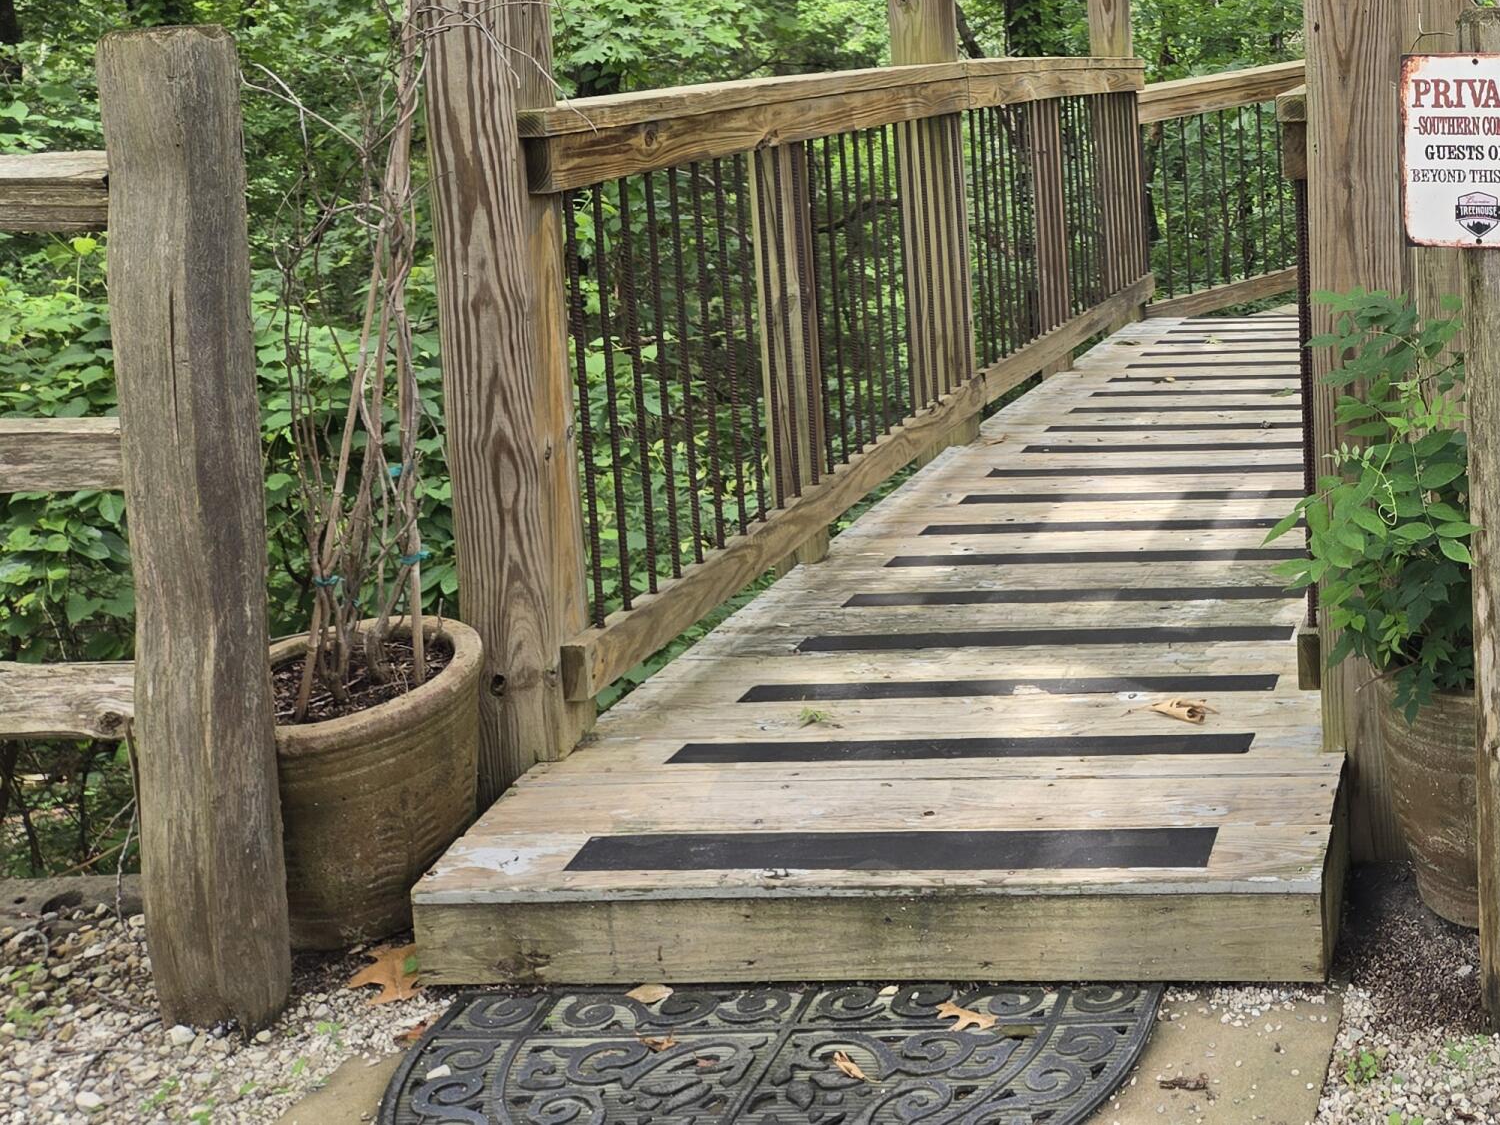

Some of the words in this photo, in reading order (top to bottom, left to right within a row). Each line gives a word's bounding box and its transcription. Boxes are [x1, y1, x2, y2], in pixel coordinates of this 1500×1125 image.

[1424, 144, 1485, 161] GUESTS
[1411, 169, 1467, 184] BEYOND
[1459, 206, 1498, 217] TREEHOUSE
